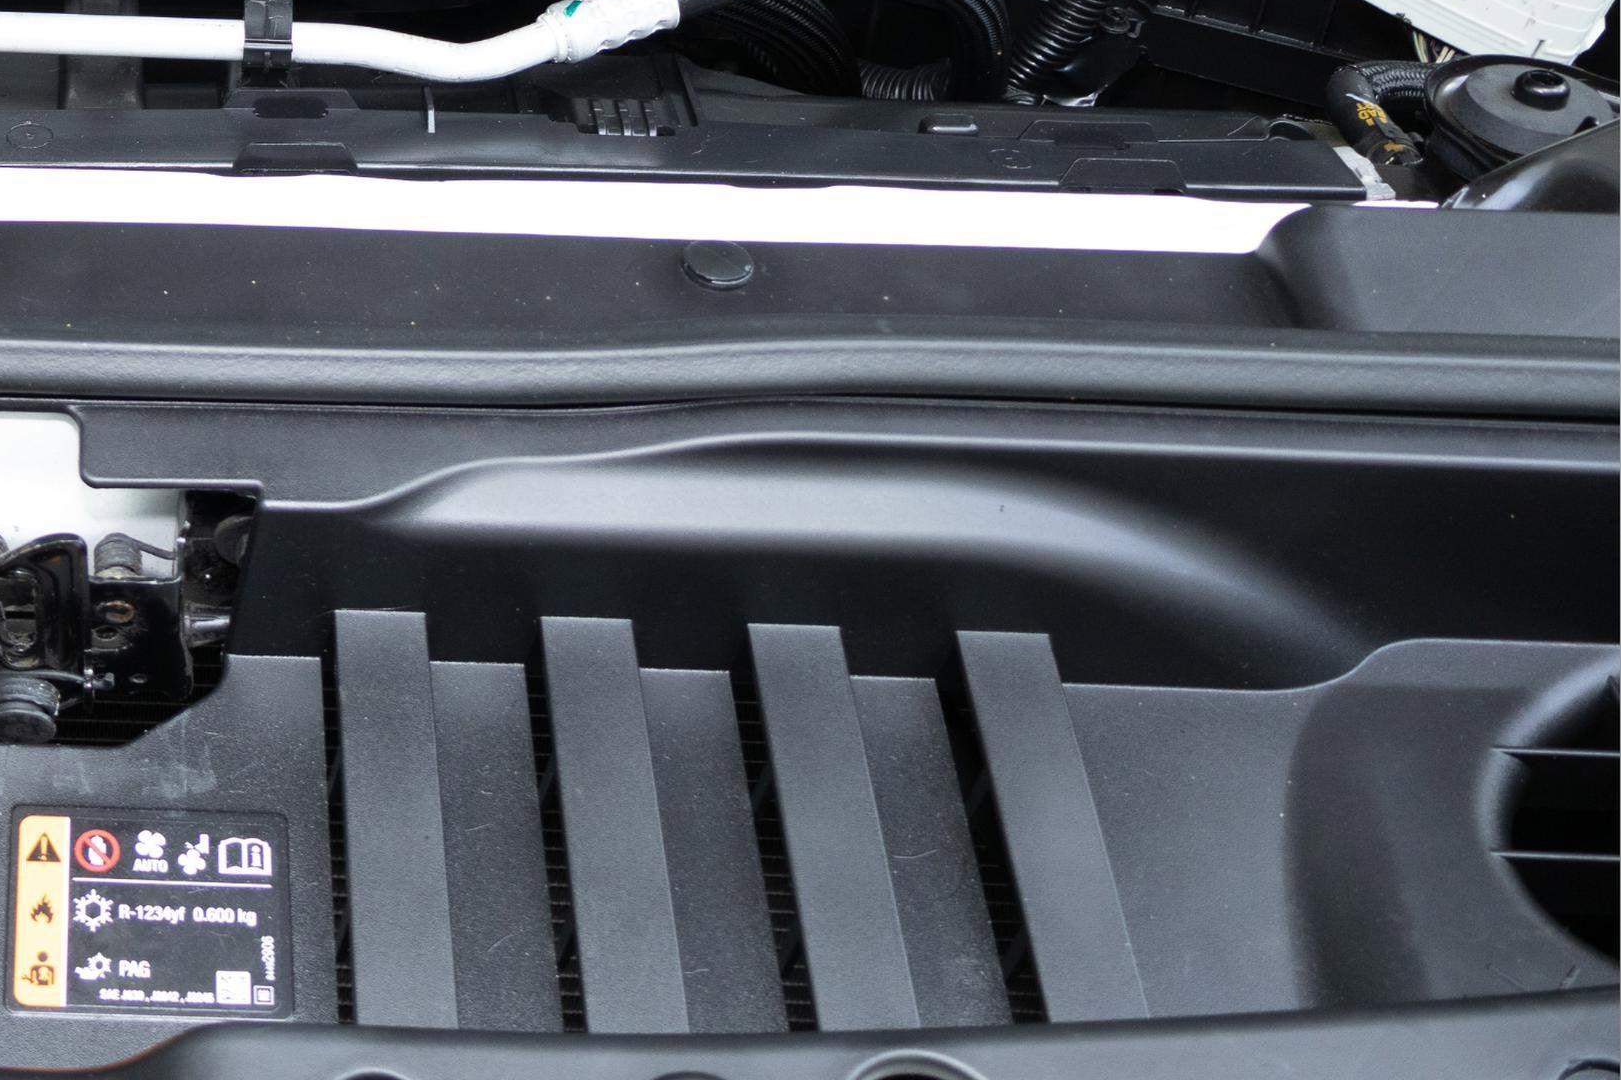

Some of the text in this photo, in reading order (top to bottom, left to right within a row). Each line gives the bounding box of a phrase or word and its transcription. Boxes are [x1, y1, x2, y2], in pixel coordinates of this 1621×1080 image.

[132, 859, 169, 873] AUTO
[118, 903, 257, 927] R-1234yf 0.600 kg
[118, 960, 151, 979] PAG
